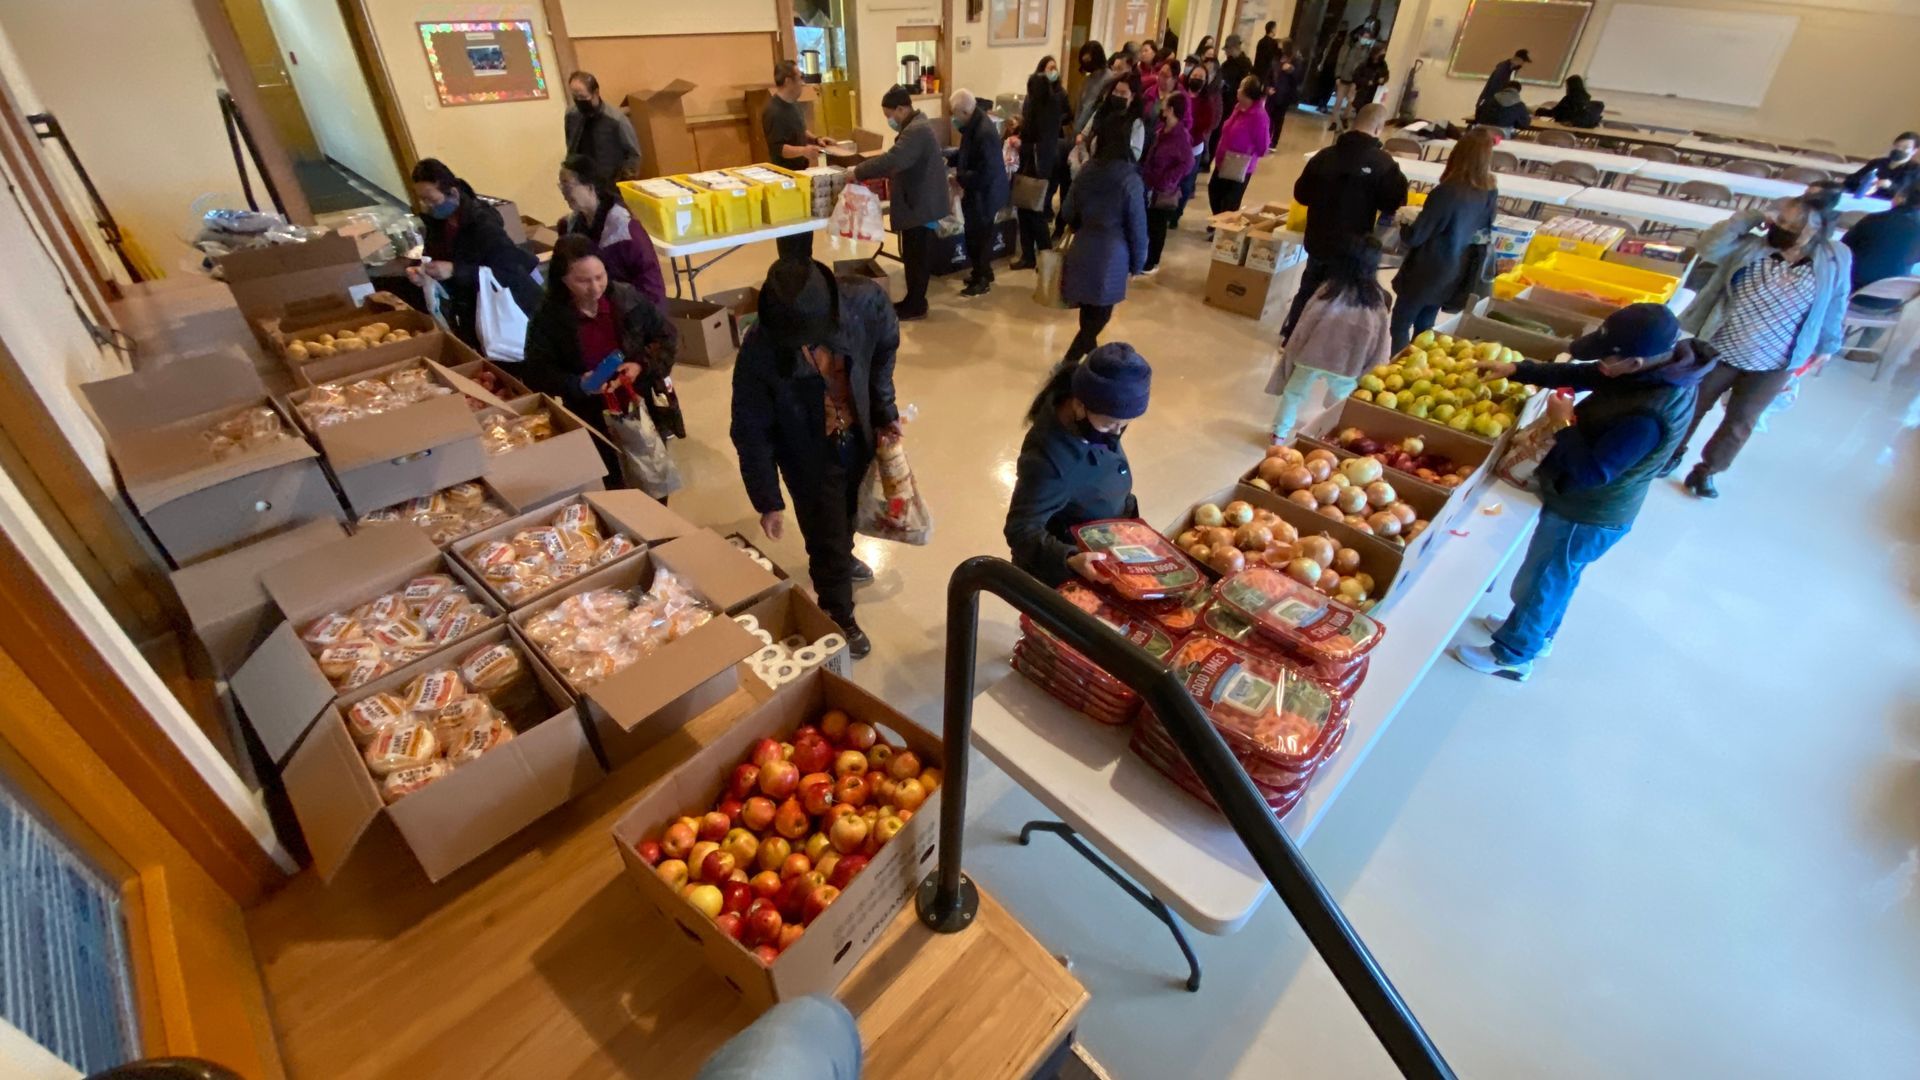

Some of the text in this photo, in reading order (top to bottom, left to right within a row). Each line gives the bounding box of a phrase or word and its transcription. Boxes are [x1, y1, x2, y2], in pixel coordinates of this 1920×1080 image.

[1310, 623, 1338, 639] TIMES
[475, 653, 502, 673] BAGELS
[1190, 673, 1210, 697] GOOD
[1204, 652, 1229, 675] TIMES
[420, 678, 434, 704] BAGELS
[861, 880, 917, 943] ORGANIC
